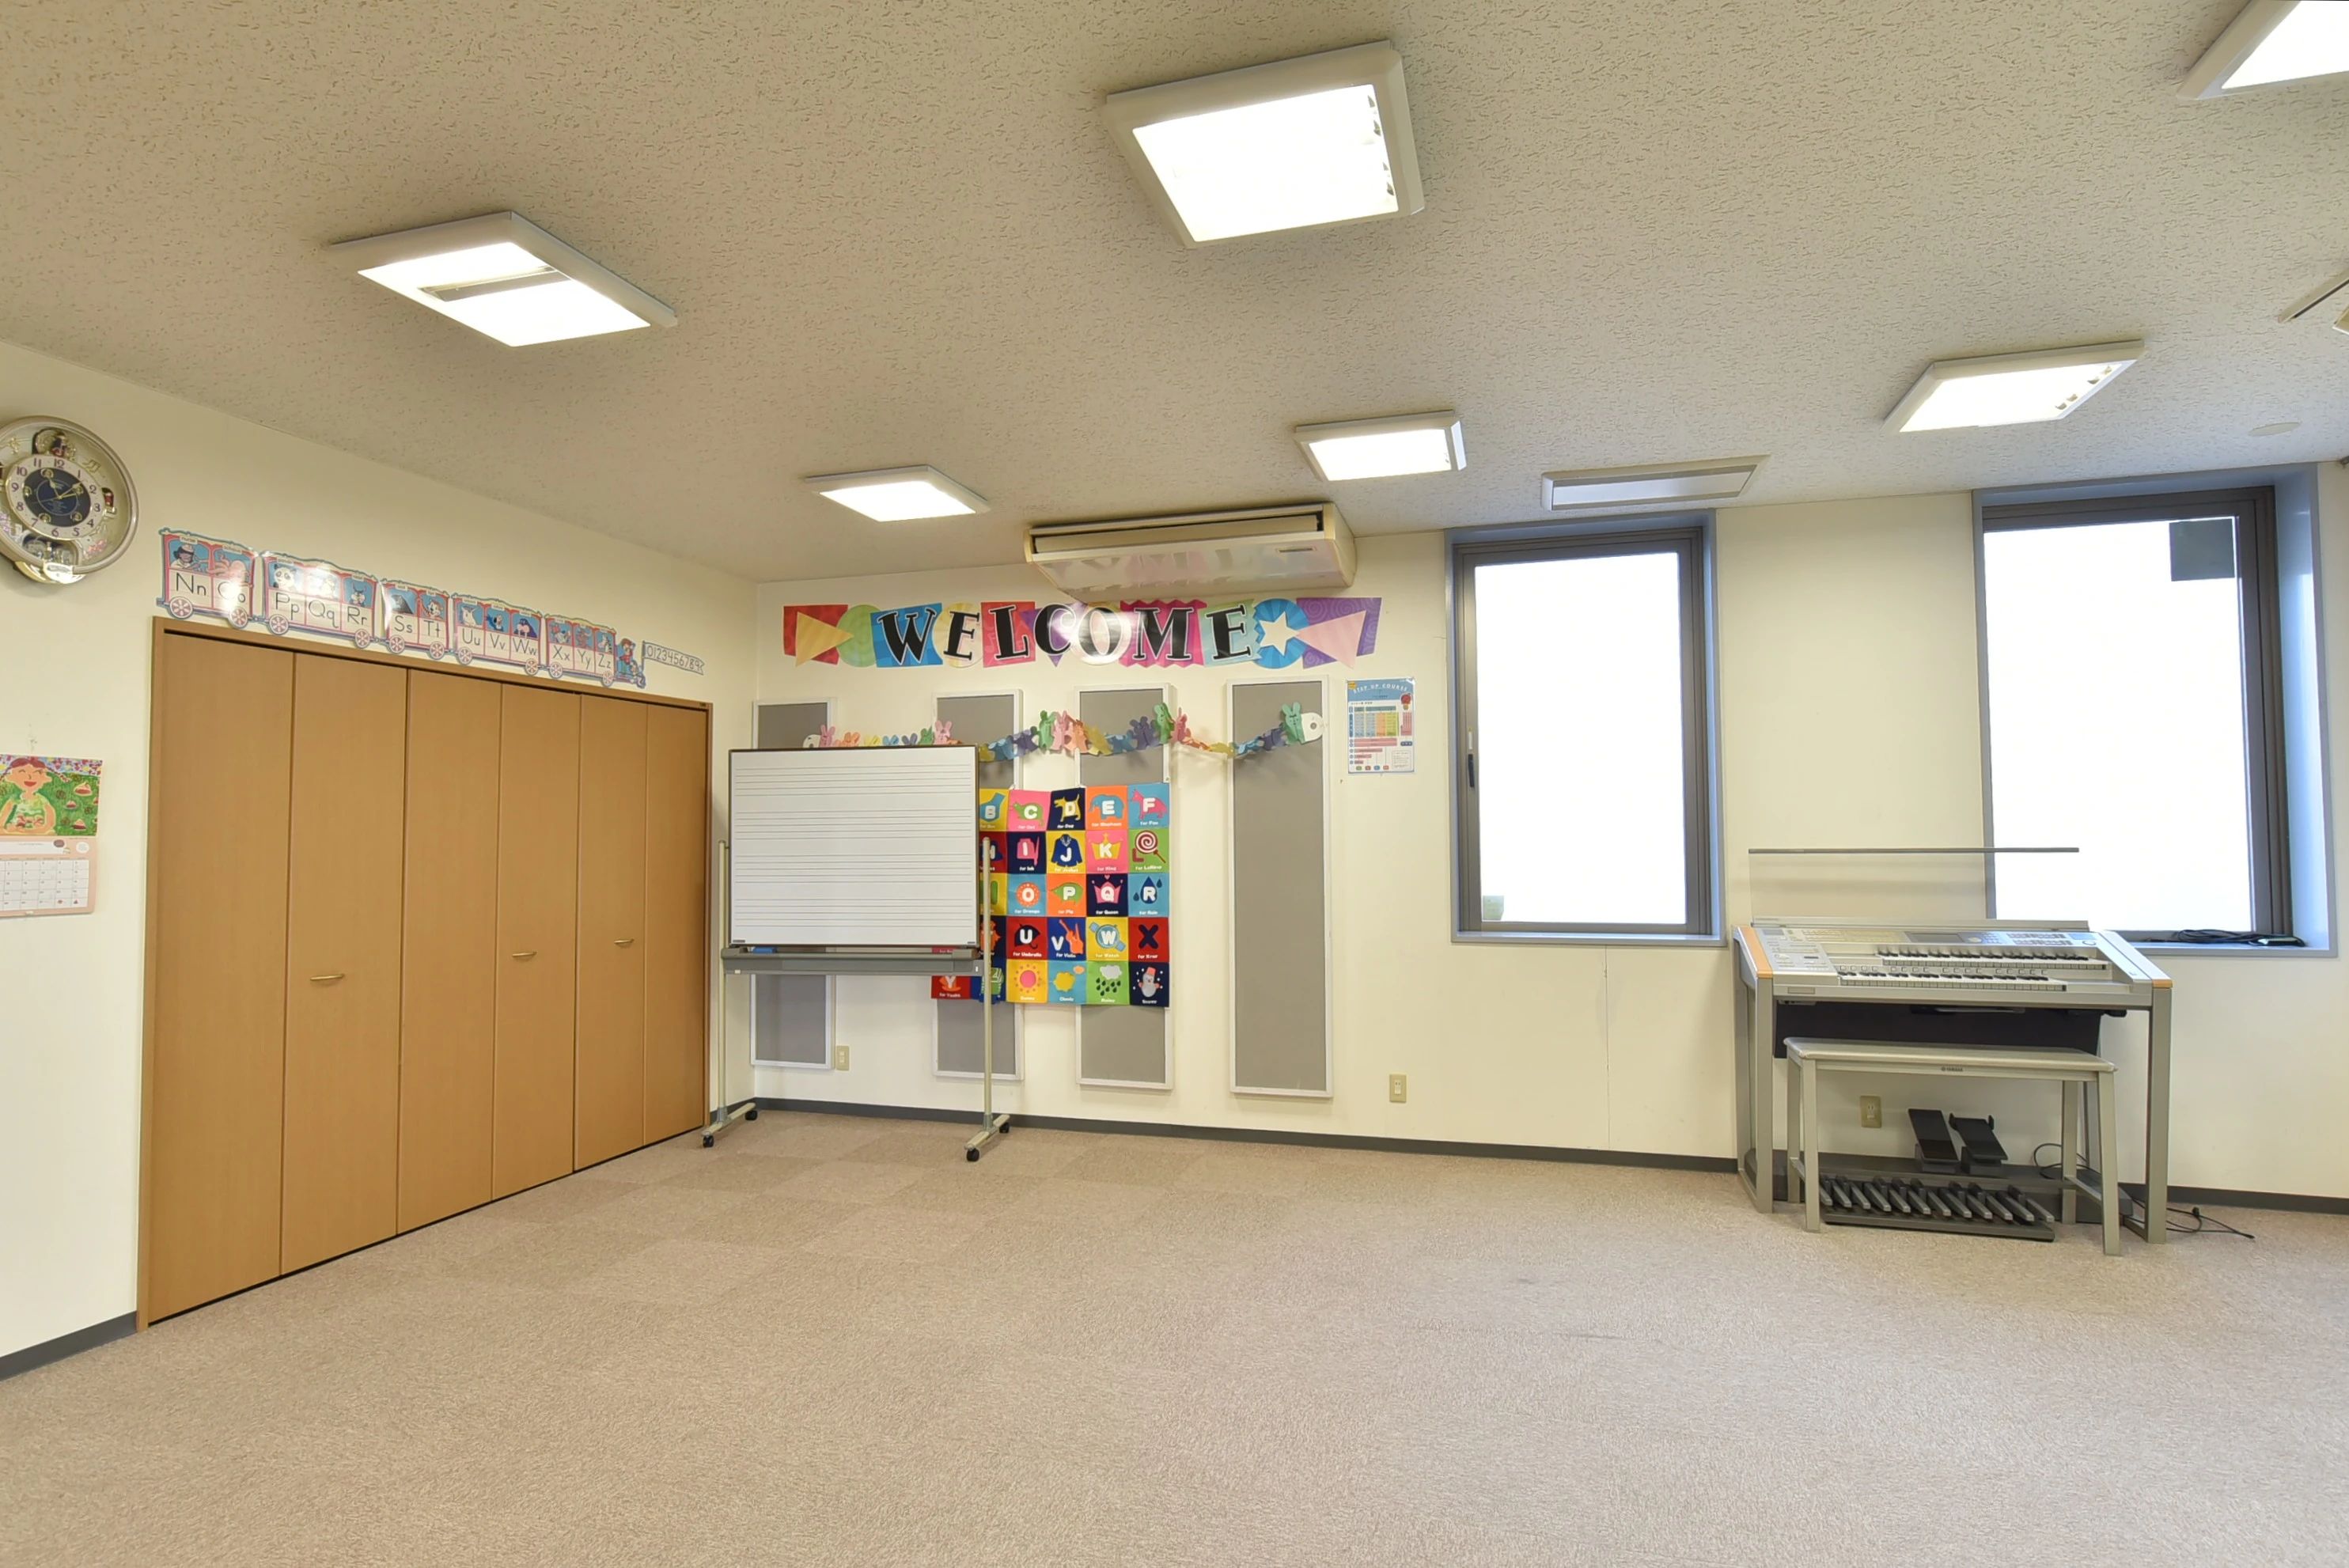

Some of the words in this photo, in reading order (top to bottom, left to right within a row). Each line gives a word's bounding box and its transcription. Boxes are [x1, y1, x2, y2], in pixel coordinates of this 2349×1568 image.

[33, 458, 41, 468] 11
[55, 458, 65, 468] 12
[17, 467, 28, 476] 10
[12, 482, 19, 492] 9
[89, 484, 97, 494] 2
[16, 502, 24, 511] 8
[94, 503, 100, 512] 3
[32, 517, 38, 527] 7
[87, 519, 94, 528] 4
[51, 528, 59, 537] 6
[72, 528, 79, 536] 5
[176, 572, 206, 596] Nn
[275, 592, 300, 620] Pp
[309, 600, 339, 629] Qq
[347, 605, 368, 625] Rr
[394, 615, 413, 633] Ss
[423, 619, 441, 638] Tt
[462, 628, 480, 646] Uu
[490, 633, 506, 650] Vv
[877, 604, 1252, 666] WELCOME
[513, 637, 537, 656] Ww
[553, 645, 570, 661] Xx
[577, 649, 591, 670] Yy
[598, 653, 612, 668] Zz
[646, 645, 700, 672] 0123456789
[984, 805, 996, 819] B
[1065, 801, 1076, 816] D
[1102, 800, 1115, 815] E
[1142, 797, 1155, 812] F
[1024, 805, 1038, 820] C
[1022, 842, 1028, 856] I
[1060, 847, 1072, 862] J
[1099, 843, 1112, 858] K
[1132, 848, 1145, 862] L
[1021, 887, 1035, 902] O
[1063, 886, 1076, 900] P
[1101, 886, 1115, 902] Q
[1142, 886, 1156, 901] R
[1020, 929, 1032, 944] U
[1051, 936, 1064, 951] V
[1101, 930, 1116, 945] W
[1138, 924, 1159, 949] X
